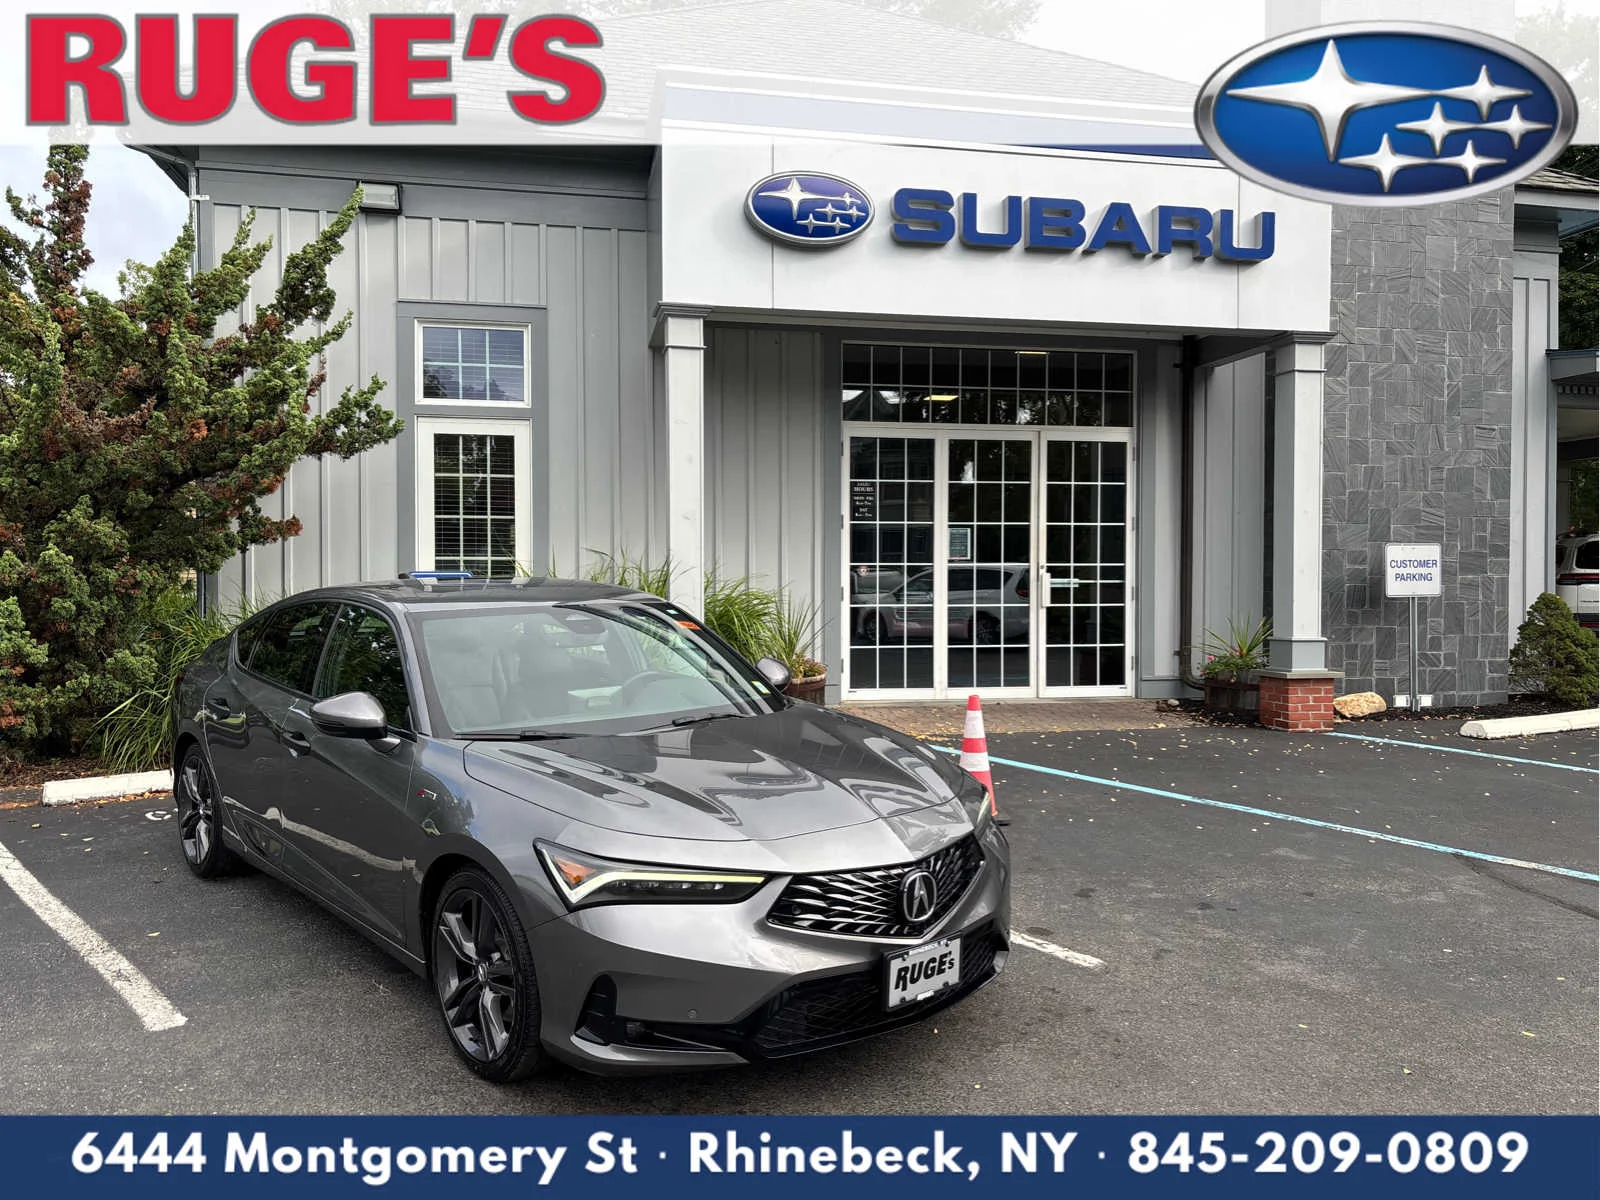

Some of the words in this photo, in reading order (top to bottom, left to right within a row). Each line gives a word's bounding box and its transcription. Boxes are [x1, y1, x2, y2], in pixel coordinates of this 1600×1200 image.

[890, 188, 1277, 262] SUBARU
[1389, 559, 1438, 569] CUSTOMER
[1394, 572, 1433, 582] PARKING
